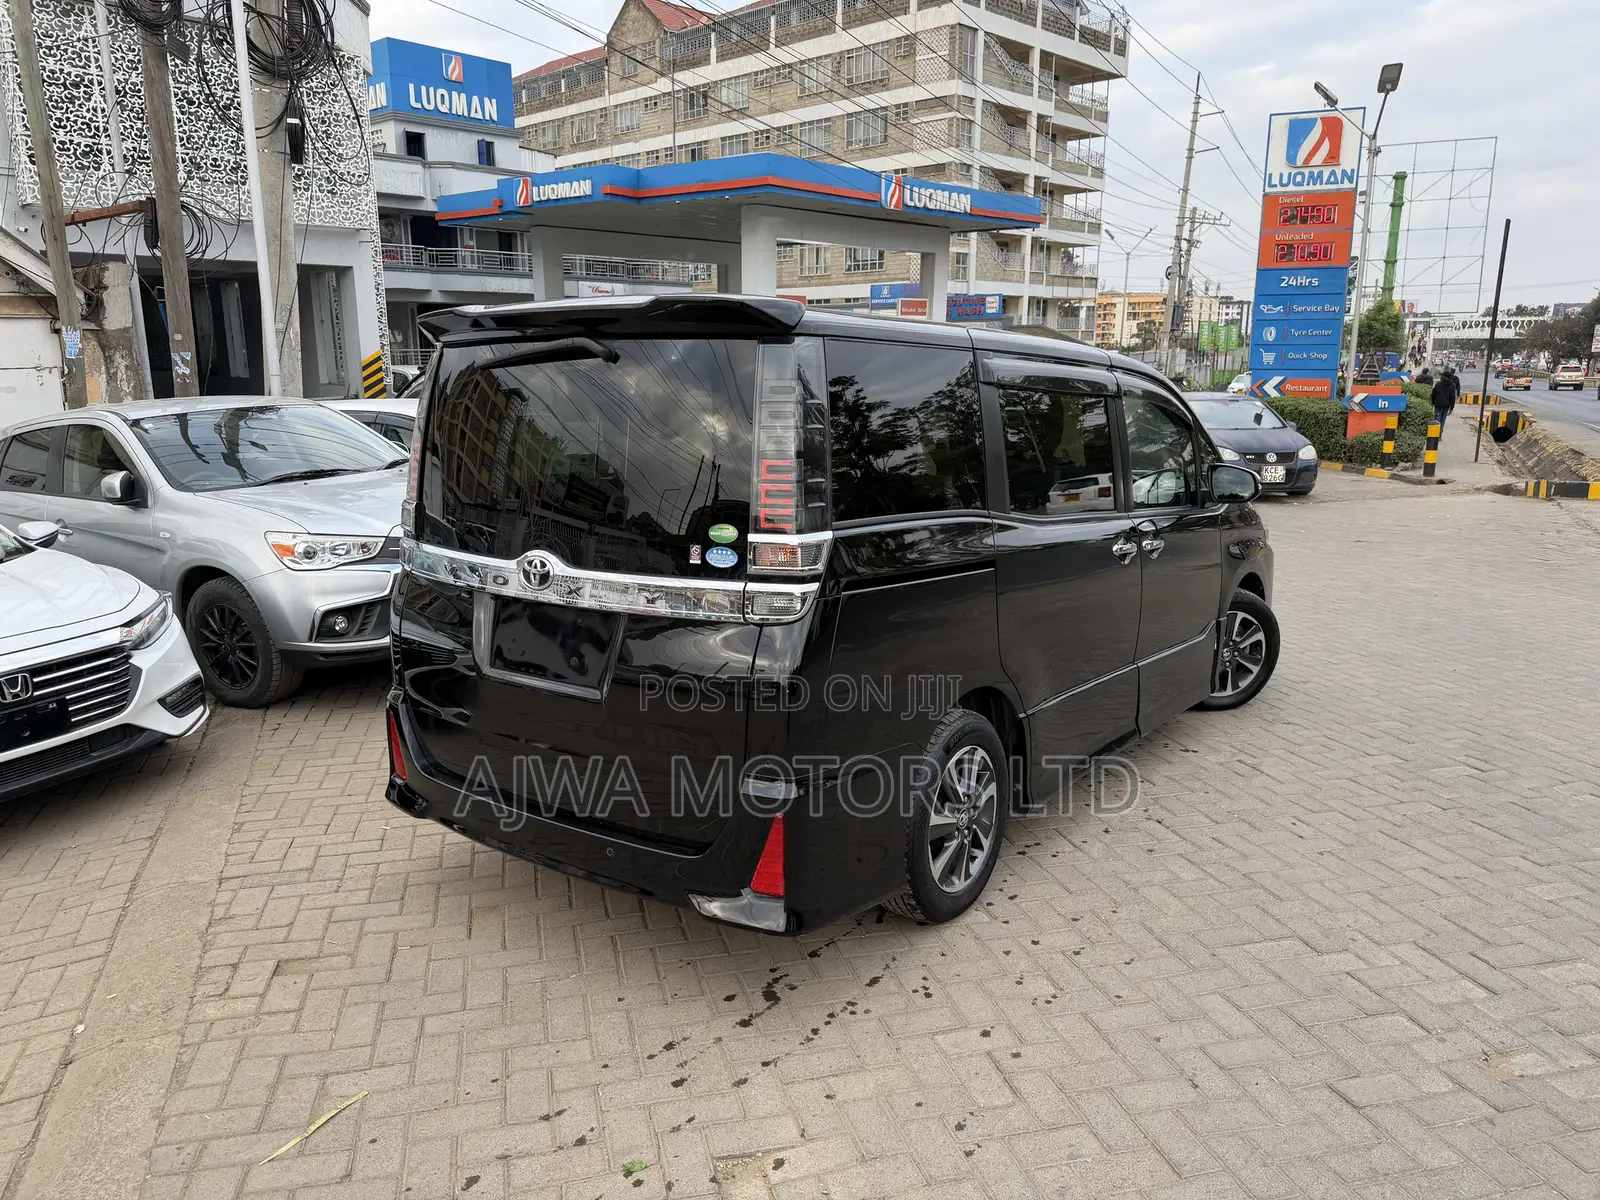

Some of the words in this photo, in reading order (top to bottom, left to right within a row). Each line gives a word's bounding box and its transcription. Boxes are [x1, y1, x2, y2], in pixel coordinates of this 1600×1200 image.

[408, 83, 498, 122] LUQMAN
[1267, 168, 1356, 188] LUQMAN
[532, 179, 593, 202] LUQMAN
[904, 184, 971, 214] LUQMAN
[1279, 195, 1304, 204] Diesel
[1275, 232, 1314, 241] Unleaded
[1280, 276, 1319, 287] 24Hrs
[1293, 304, 1323, 313] Service
[1324, 303, 1340, 314] Bay
[1291, 329, 1307, 337] Tyre
[1308, 328, 1333, 336] Center
[1288, 352, 1308, 360] Quick
[1309, 352, 1328, 361] Shop
[1285, 383, 1328, 392] Restaurant
[1378, 399, 1389, 409] In
